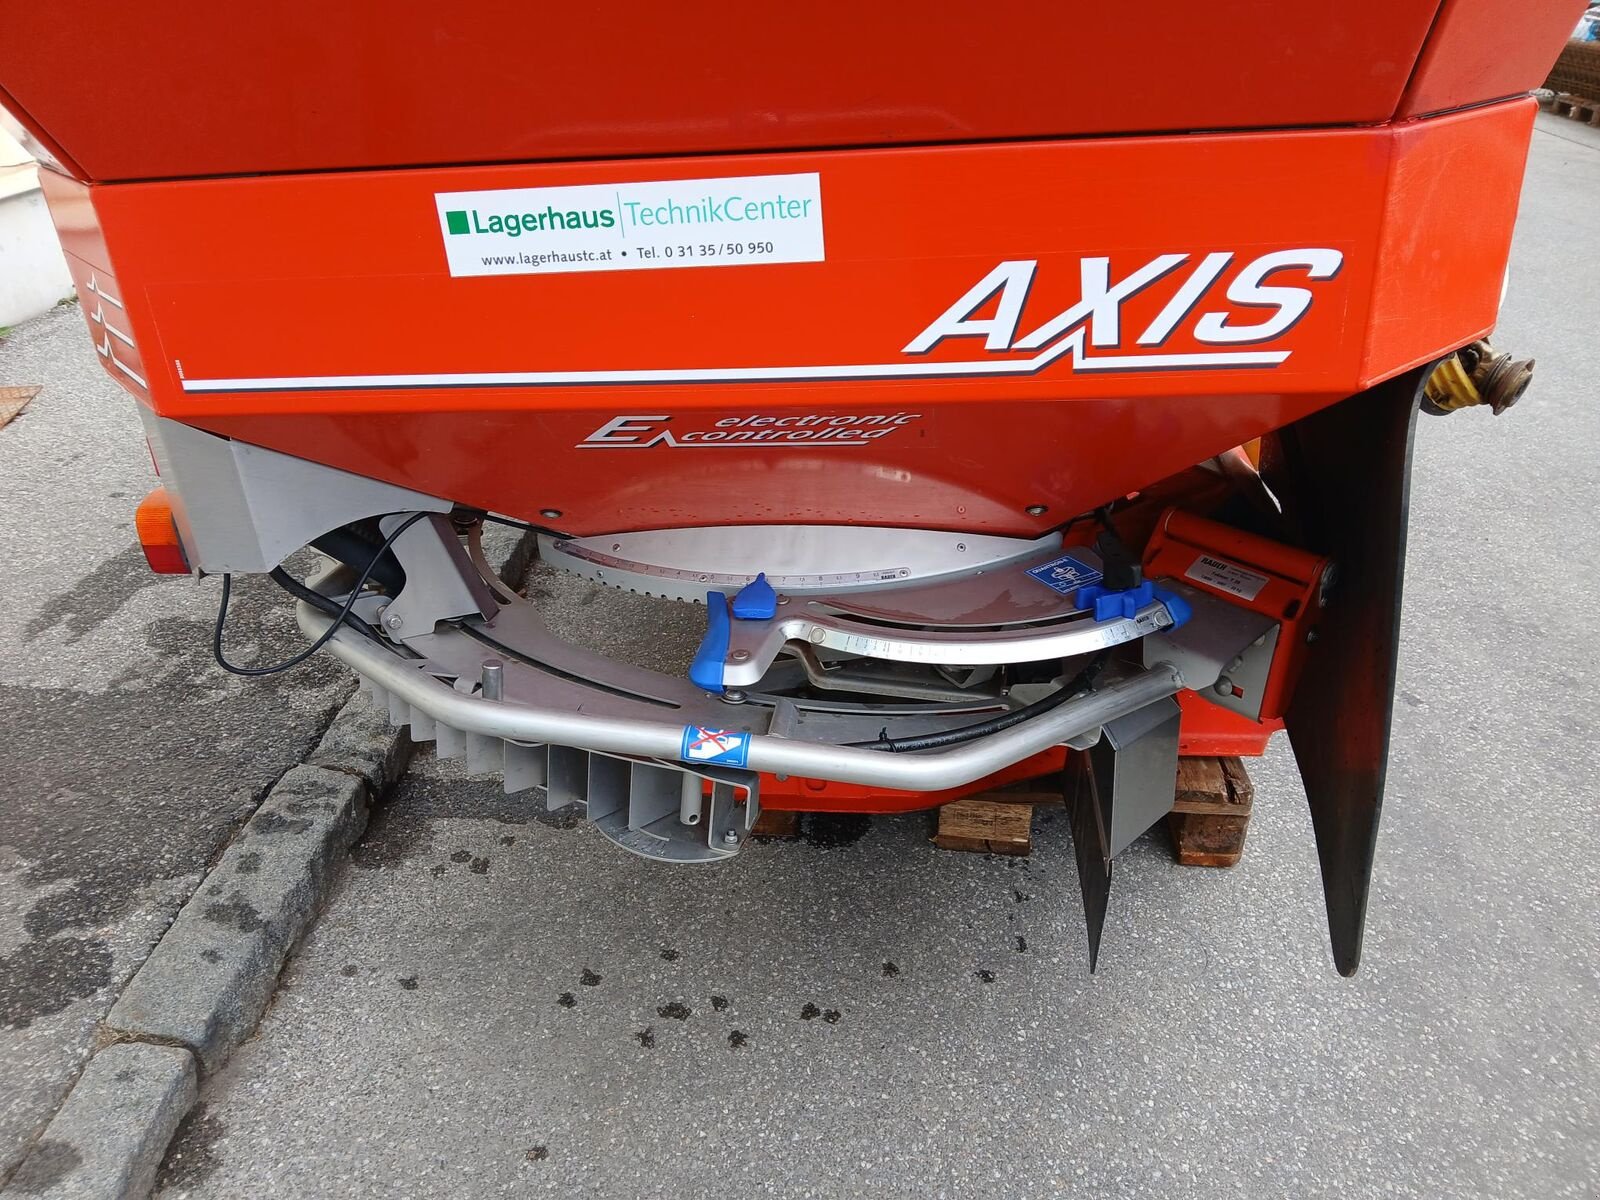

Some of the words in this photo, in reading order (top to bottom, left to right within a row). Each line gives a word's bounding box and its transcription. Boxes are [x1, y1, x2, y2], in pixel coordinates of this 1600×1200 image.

[472, 206, 616, 238] Lagerhaus
[624, 195, 813, 227] TechnikCenter
[481, 249, 613, 267] www.lagerhaustc.at
[636, 247, 661, 259] Tel.
[664, 246, 673, 258] 0
[677, 245, 694, 257] 31
[748, 241, 774, 254] 950
[900, 248, 1344, 353] AXIS
[714, 411, 923, 428] electronic
[680, 426, 899, 442] controlled
